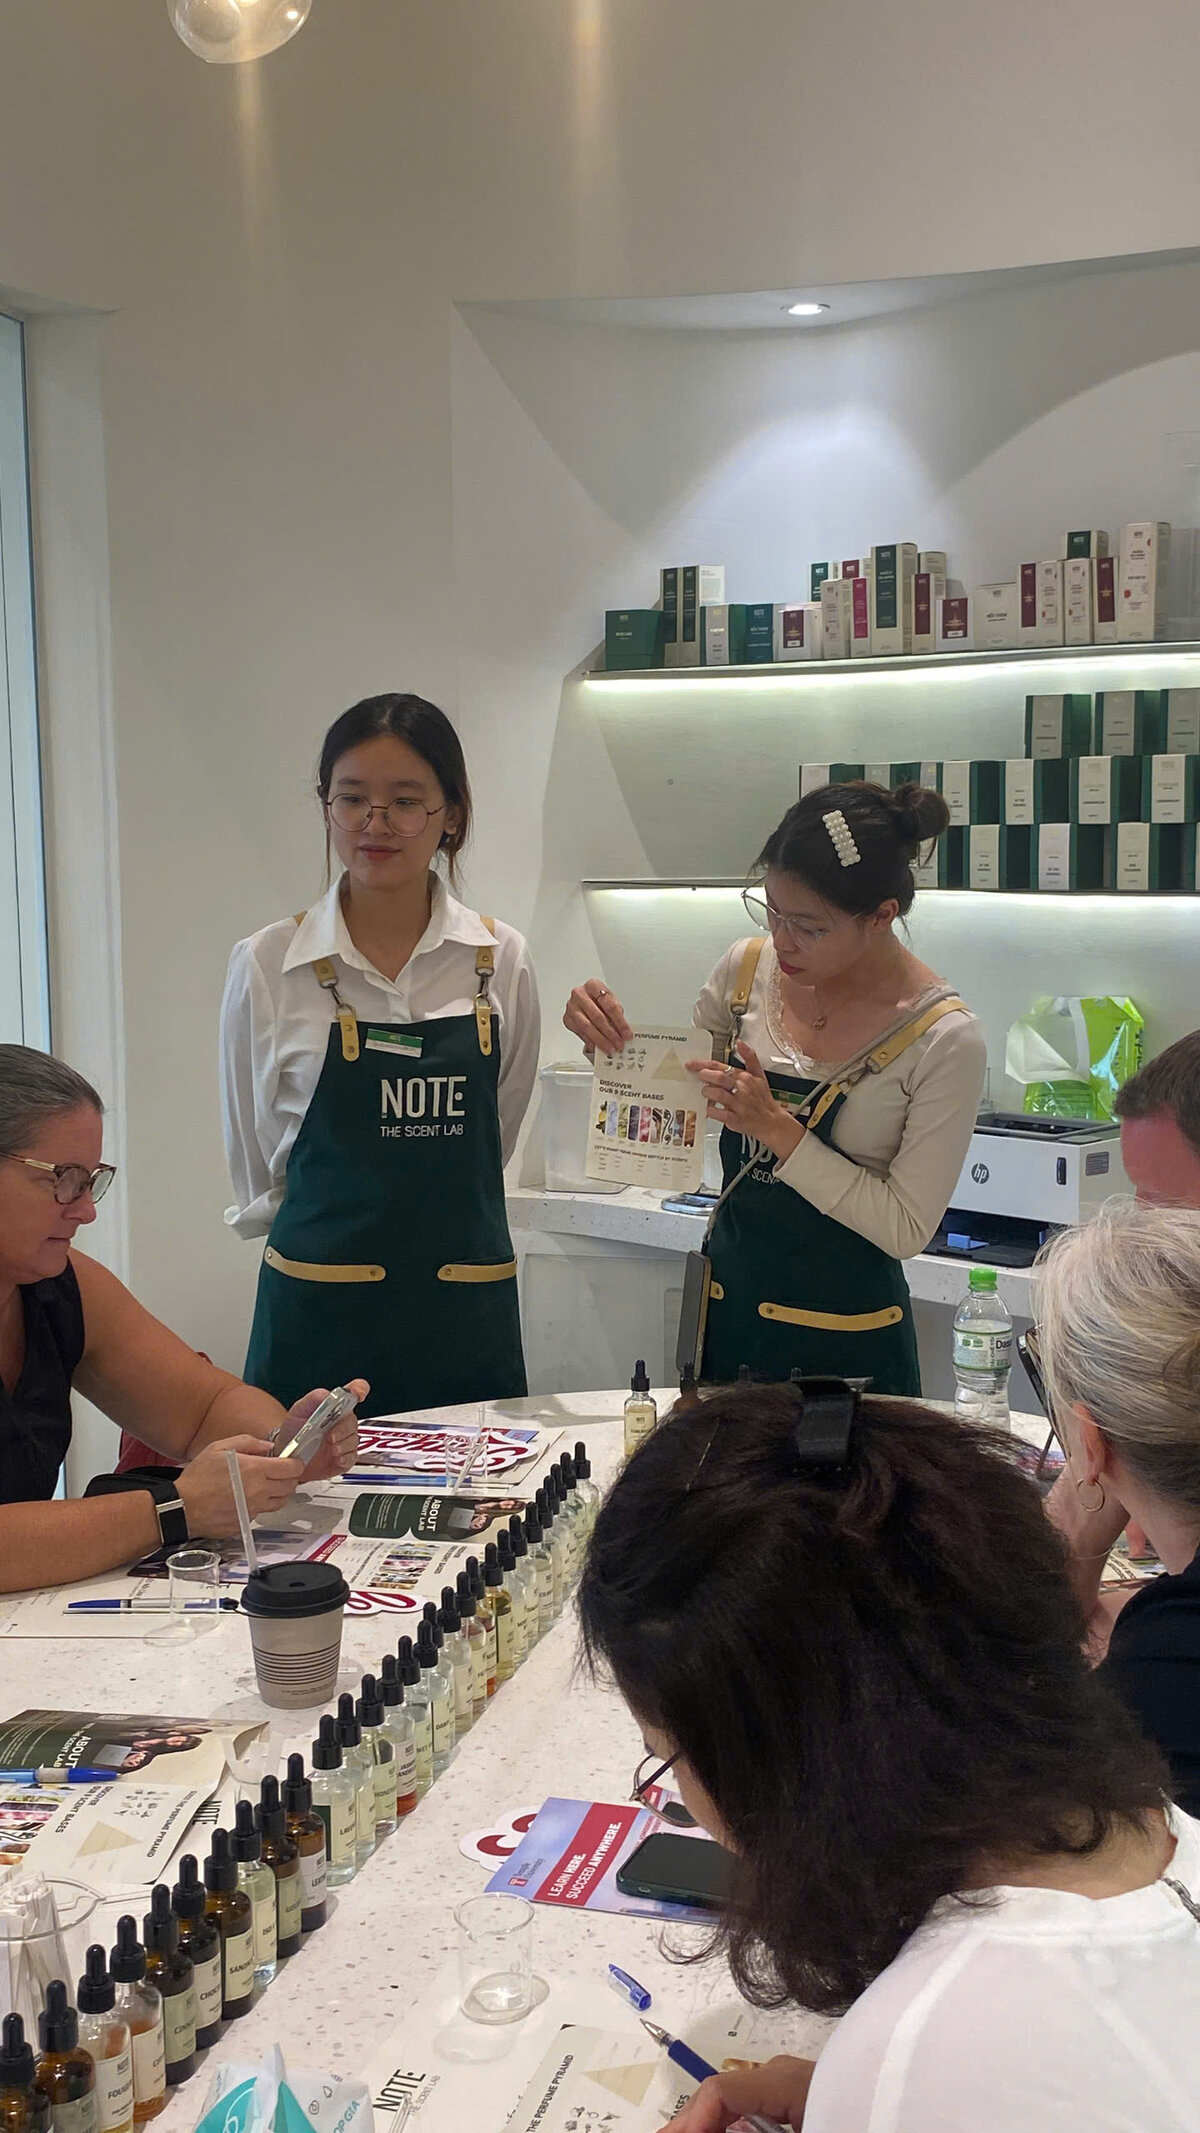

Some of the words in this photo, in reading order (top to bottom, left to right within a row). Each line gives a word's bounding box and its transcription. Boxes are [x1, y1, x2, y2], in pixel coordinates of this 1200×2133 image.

[381, 1076, 467, 1118] NOTE
[600, 1080, 632, 1090] DISCOVER
[620, 1090, 641, 1098] SCENT
[642, 1093, 664, 1101] BASES
[380, 1126, 401, 1138] THE
[404, 1125, 441, 1137] SCENT
[444, 1124, 464, 1136] LAB
[427, 1499, 442, 1532] ABOUT
[65, 1736, 92, 1769] ABOUT
[68, 1796, 89, 1815] SCENT
[55, 1813, 75, 1834] BASES
[547, 1873, 573, 1897] LEARN
[565, 1853, 587, 1874] HERE.
[565, 1866, 596, 1900] SUCCEED
[587, 1822, 623, 1868] ANYWHERE.
[372, 2069, 427, 2112] NOTE
[534, 2085, 559, 2119] PERFUME
[551, 2054, 574, 2085] PYRAMID
